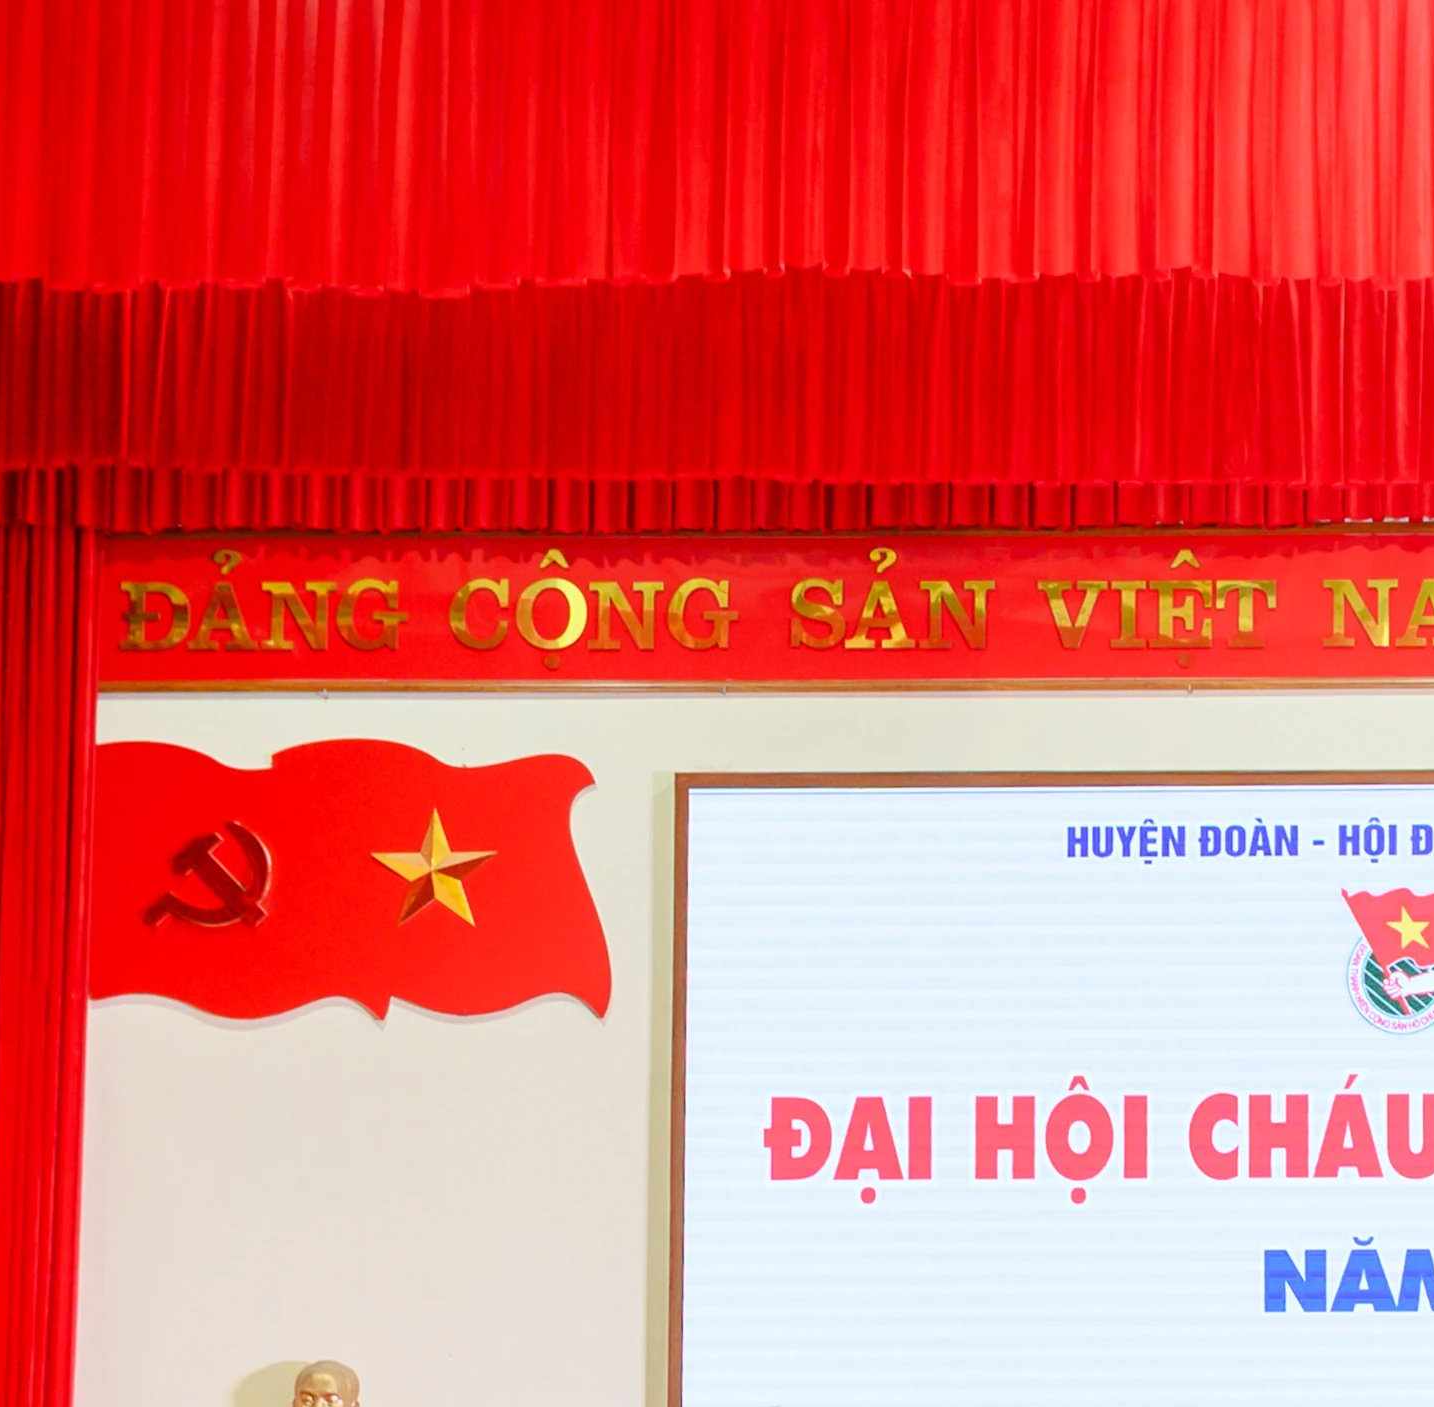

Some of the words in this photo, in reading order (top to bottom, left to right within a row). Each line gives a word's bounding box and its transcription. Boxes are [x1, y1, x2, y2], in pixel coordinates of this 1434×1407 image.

[118, 549, 400, 653] ĐẢNG
[449, 549, 739, 670] CỘNG
[790, 547, 996, 653] SẢN
[1037, 549, 1276, 668] VIỆT
[1068, 819, 1185, 864] HUYỆN
[1198, 818, 1298, 857] ĐOÀN
[1339, 817, 1397, 863] HỘI
[764, 1097, 932, 1204] ĐẠI
[975, 1076, 1147, 1204] HỘI
